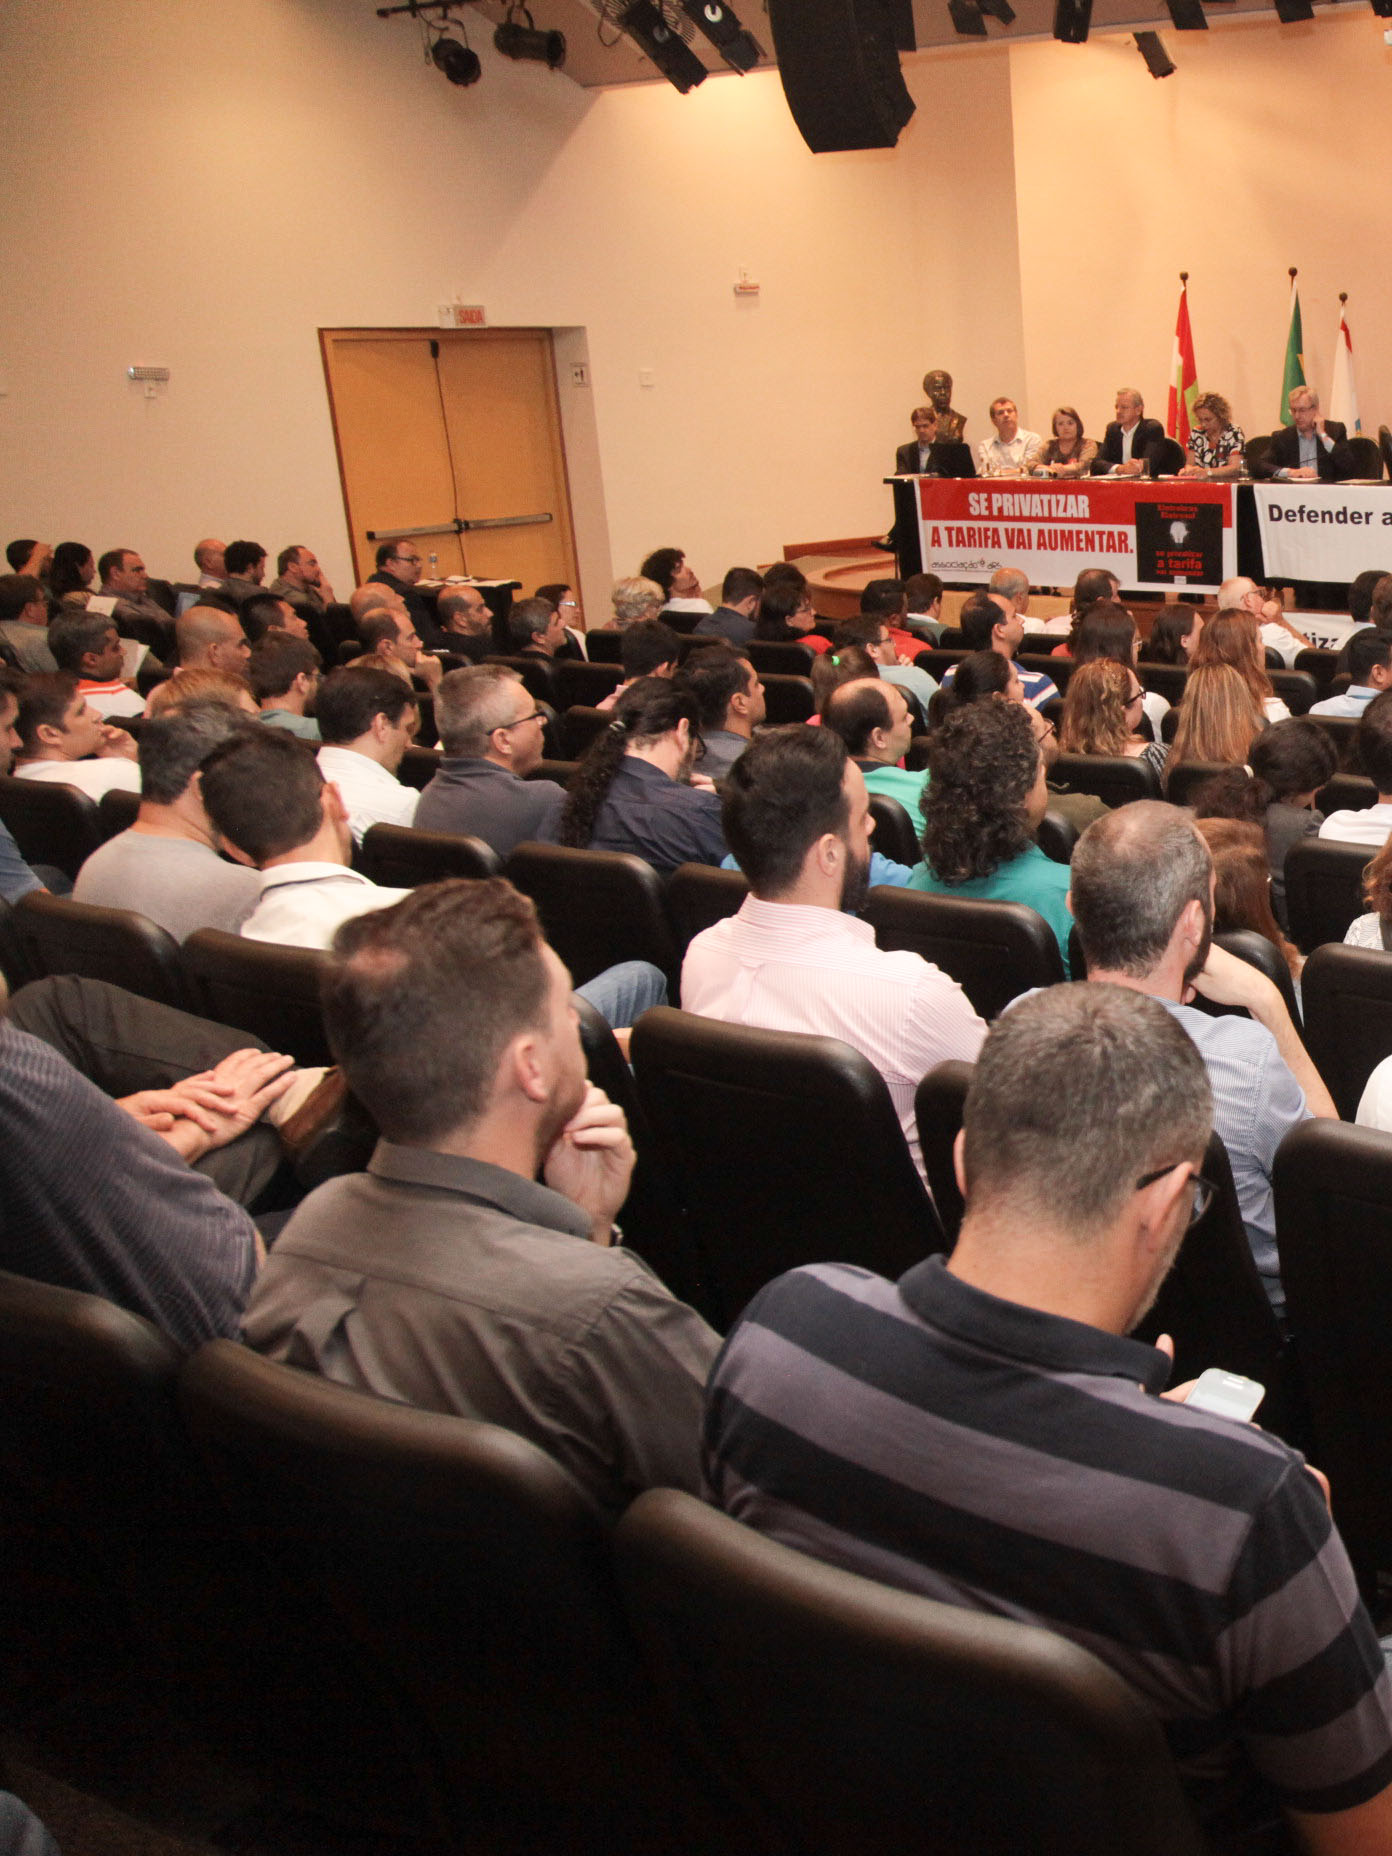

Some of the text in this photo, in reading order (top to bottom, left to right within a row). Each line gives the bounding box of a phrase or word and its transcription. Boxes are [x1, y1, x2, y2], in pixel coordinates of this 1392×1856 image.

[968, 492, 1090, 518] SE PRIVATIZAR
[1268, 504, 1374, 525] Defender
[931, 526, 1134, 554] A TARIFA VAI AUMENTAR.
[1157, 558, 1203, 569] a tarifa
